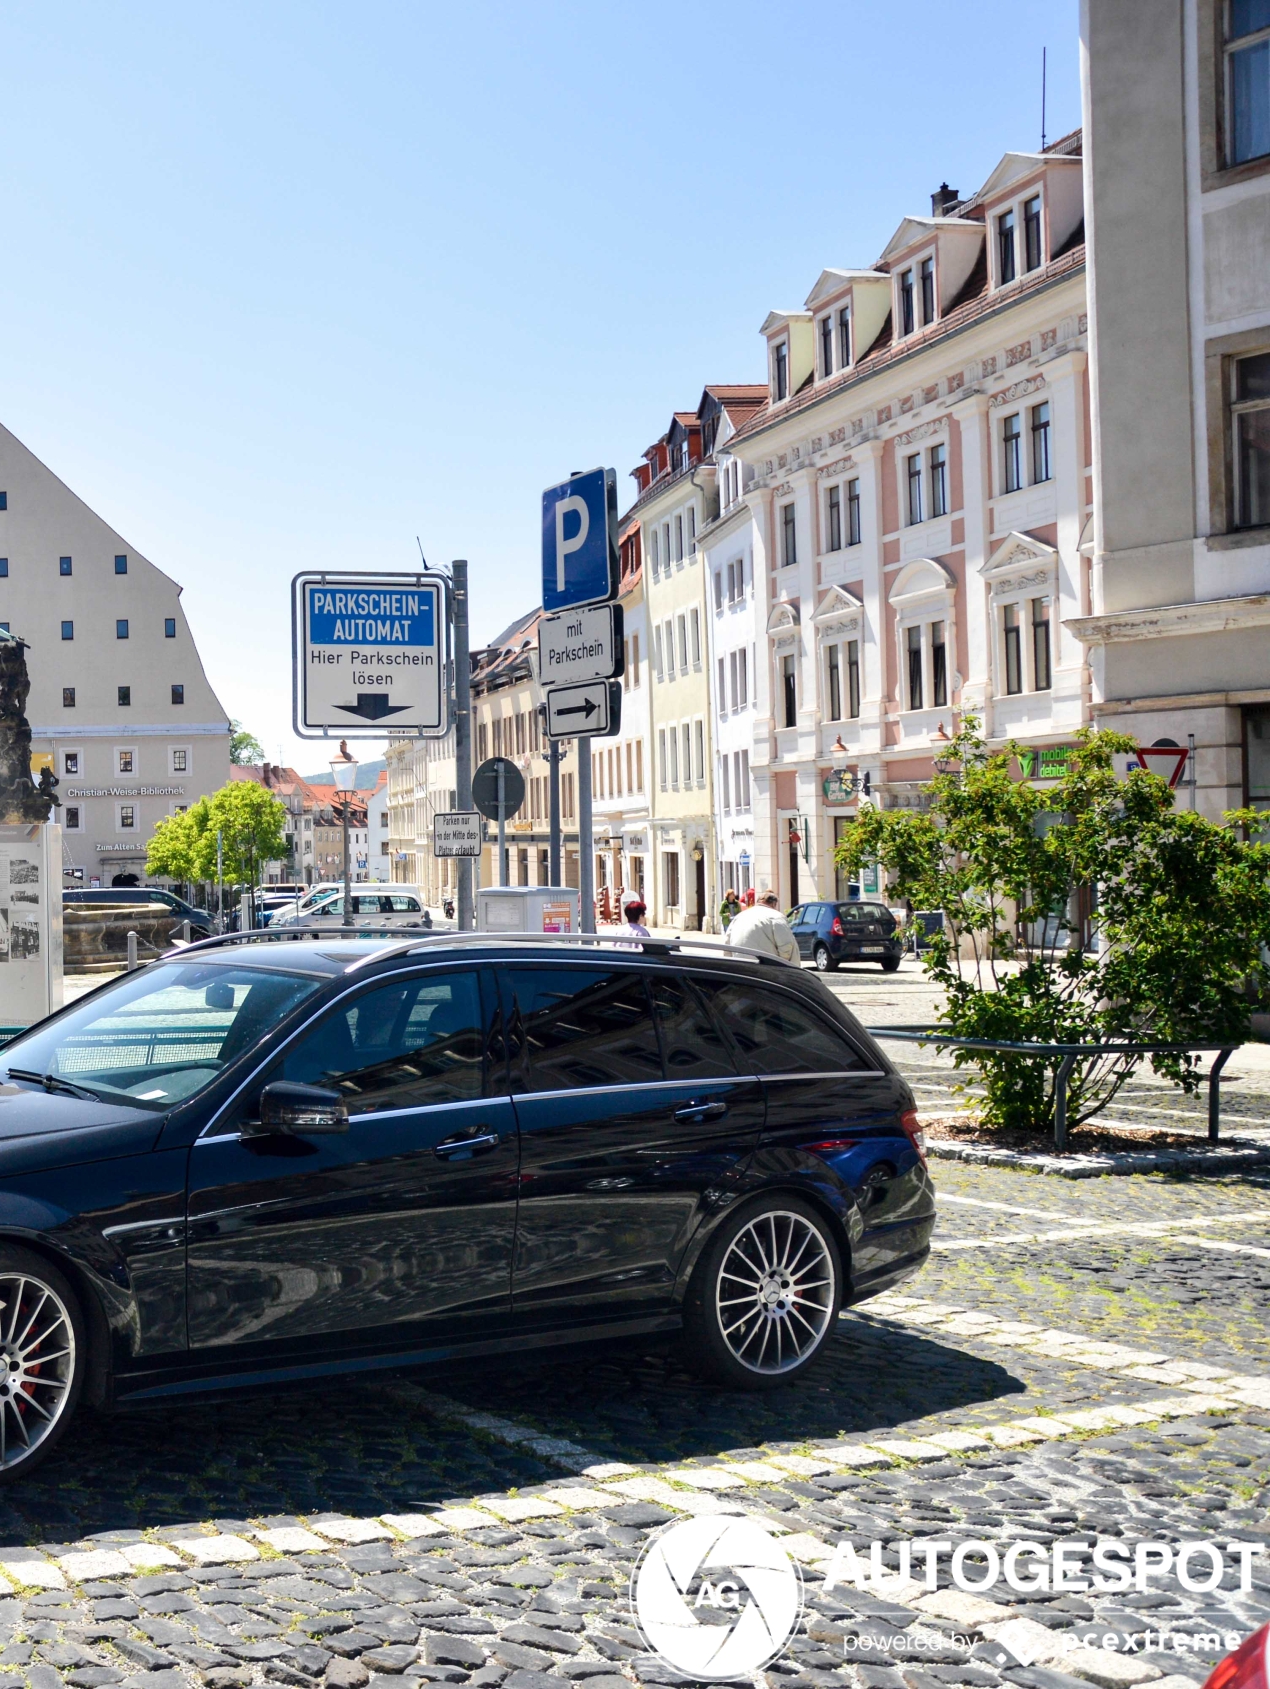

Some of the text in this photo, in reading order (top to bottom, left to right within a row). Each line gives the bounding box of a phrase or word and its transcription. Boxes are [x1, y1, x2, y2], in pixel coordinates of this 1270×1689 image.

[555, 494, 589, 592] P
[314, 593, 430, 616] PARKSCHEIN-
[333, 620, 411, 642] AUTOMAT
[566, 620, 583, 637] mit
[311, 651, 434, 667] Hier Parkschein
[548, 639, 604, 666] Parkschein
[352, 670, 393, 686] lösen
[67, 786, 185, 798] Christian-Weise-Bibliothek
[443, 816, 460, 826] Parken
[453, 830, 465, 840] Mitte
[467, 830, 476, 839] des
[113, 843, 135, 851] Alten
[455, 845, 475, 855] erlaubt
